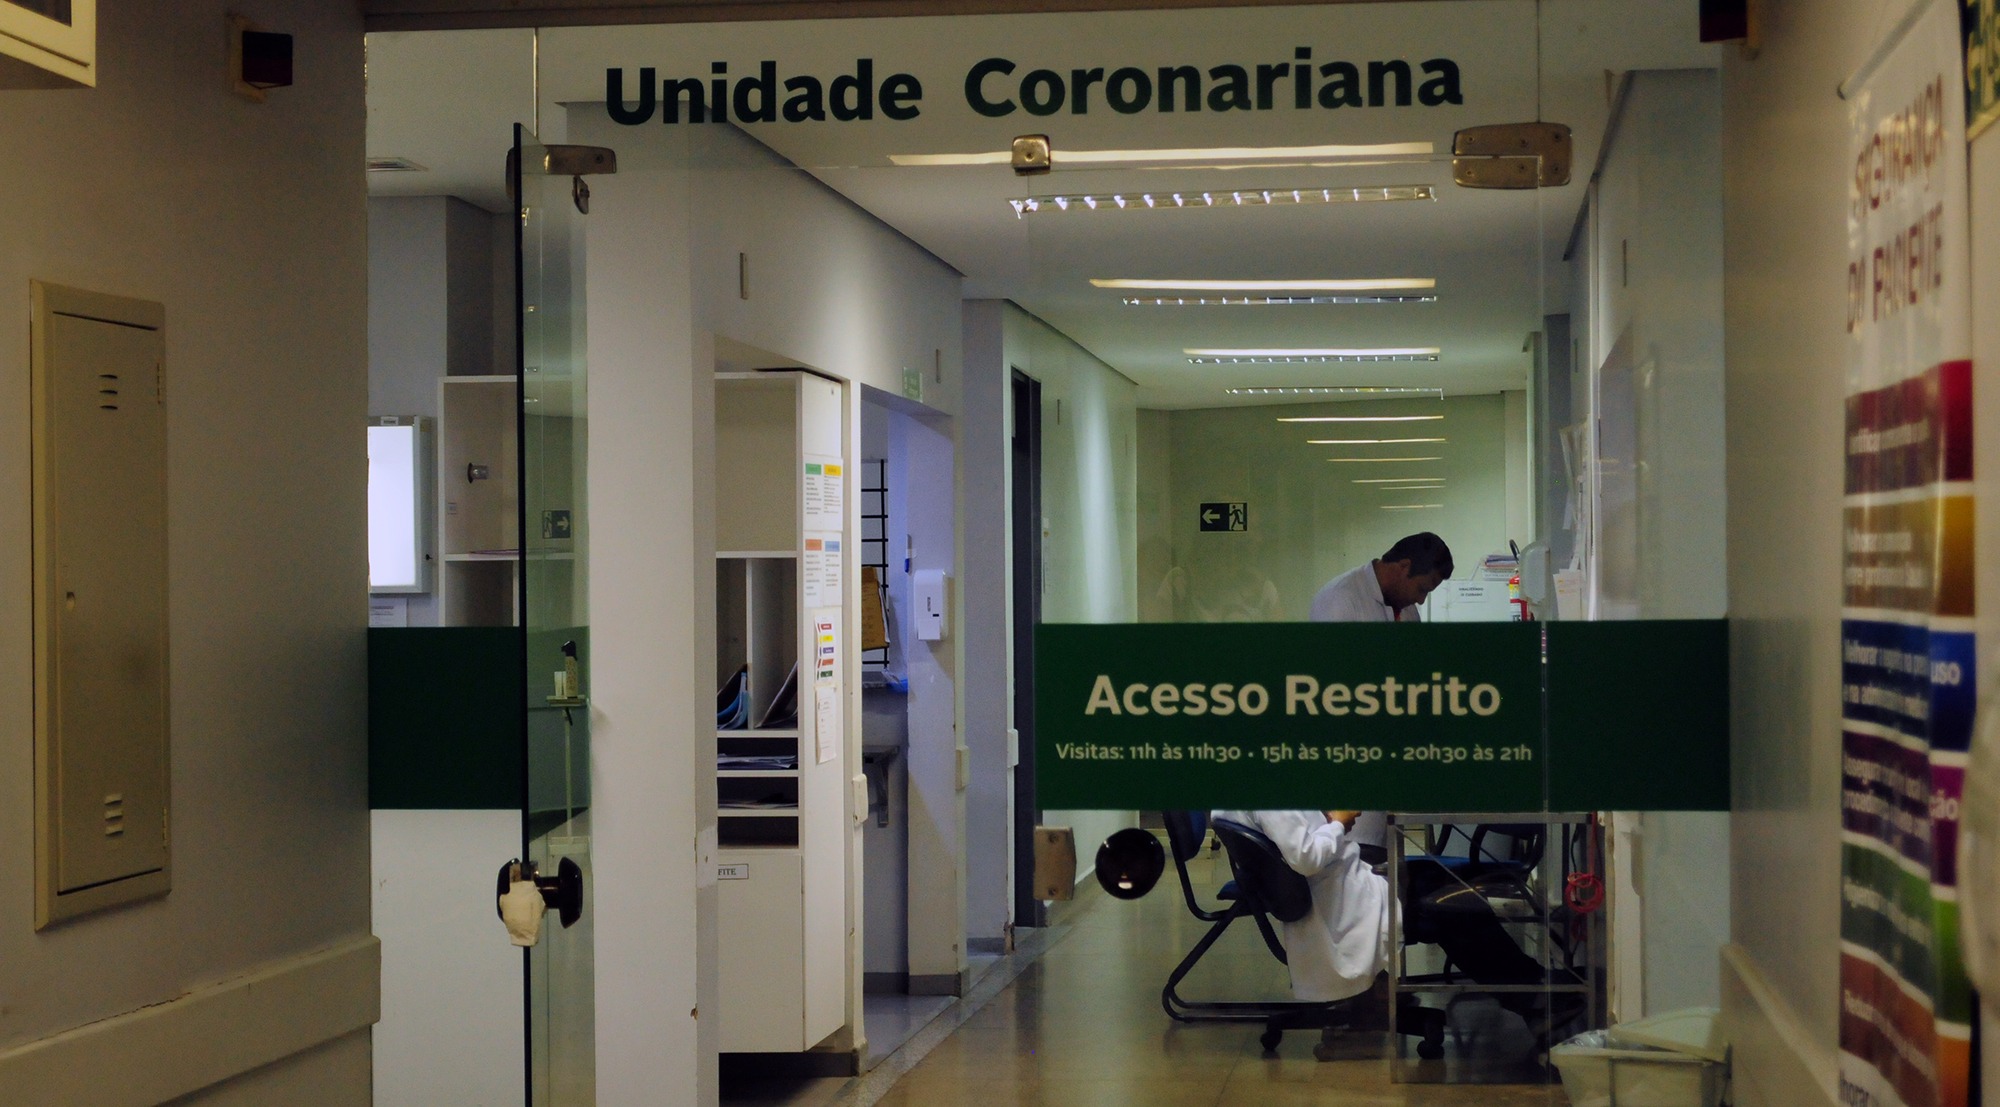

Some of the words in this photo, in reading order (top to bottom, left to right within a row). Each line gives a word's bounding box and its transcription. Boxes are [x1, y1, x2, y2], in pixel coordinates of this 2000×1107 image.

[605, 59, 922, 125] Unidade
[965, 47, 1462, 118] Coronariana
[1084, 674, 1269, 716] Acesso
[1286, 671, 1501, 716] Restrito
[1056, 743, 1124, 760] Visitas:
[1130, 743, 1157, 760] 11h
[1162, 743, 1183, 760] às
[1188, 743, 1241, 763] 11h30
[1262, 743, 1293, 763] 15h
[1298, 743, 1319, 760] às
[1325, 743, 1382, 763] 15h30
[1403, 743, 1467, 763] 20h30
[1473, 743, 1494, 760] às
[1501, 744, 1532, 761] 21h
